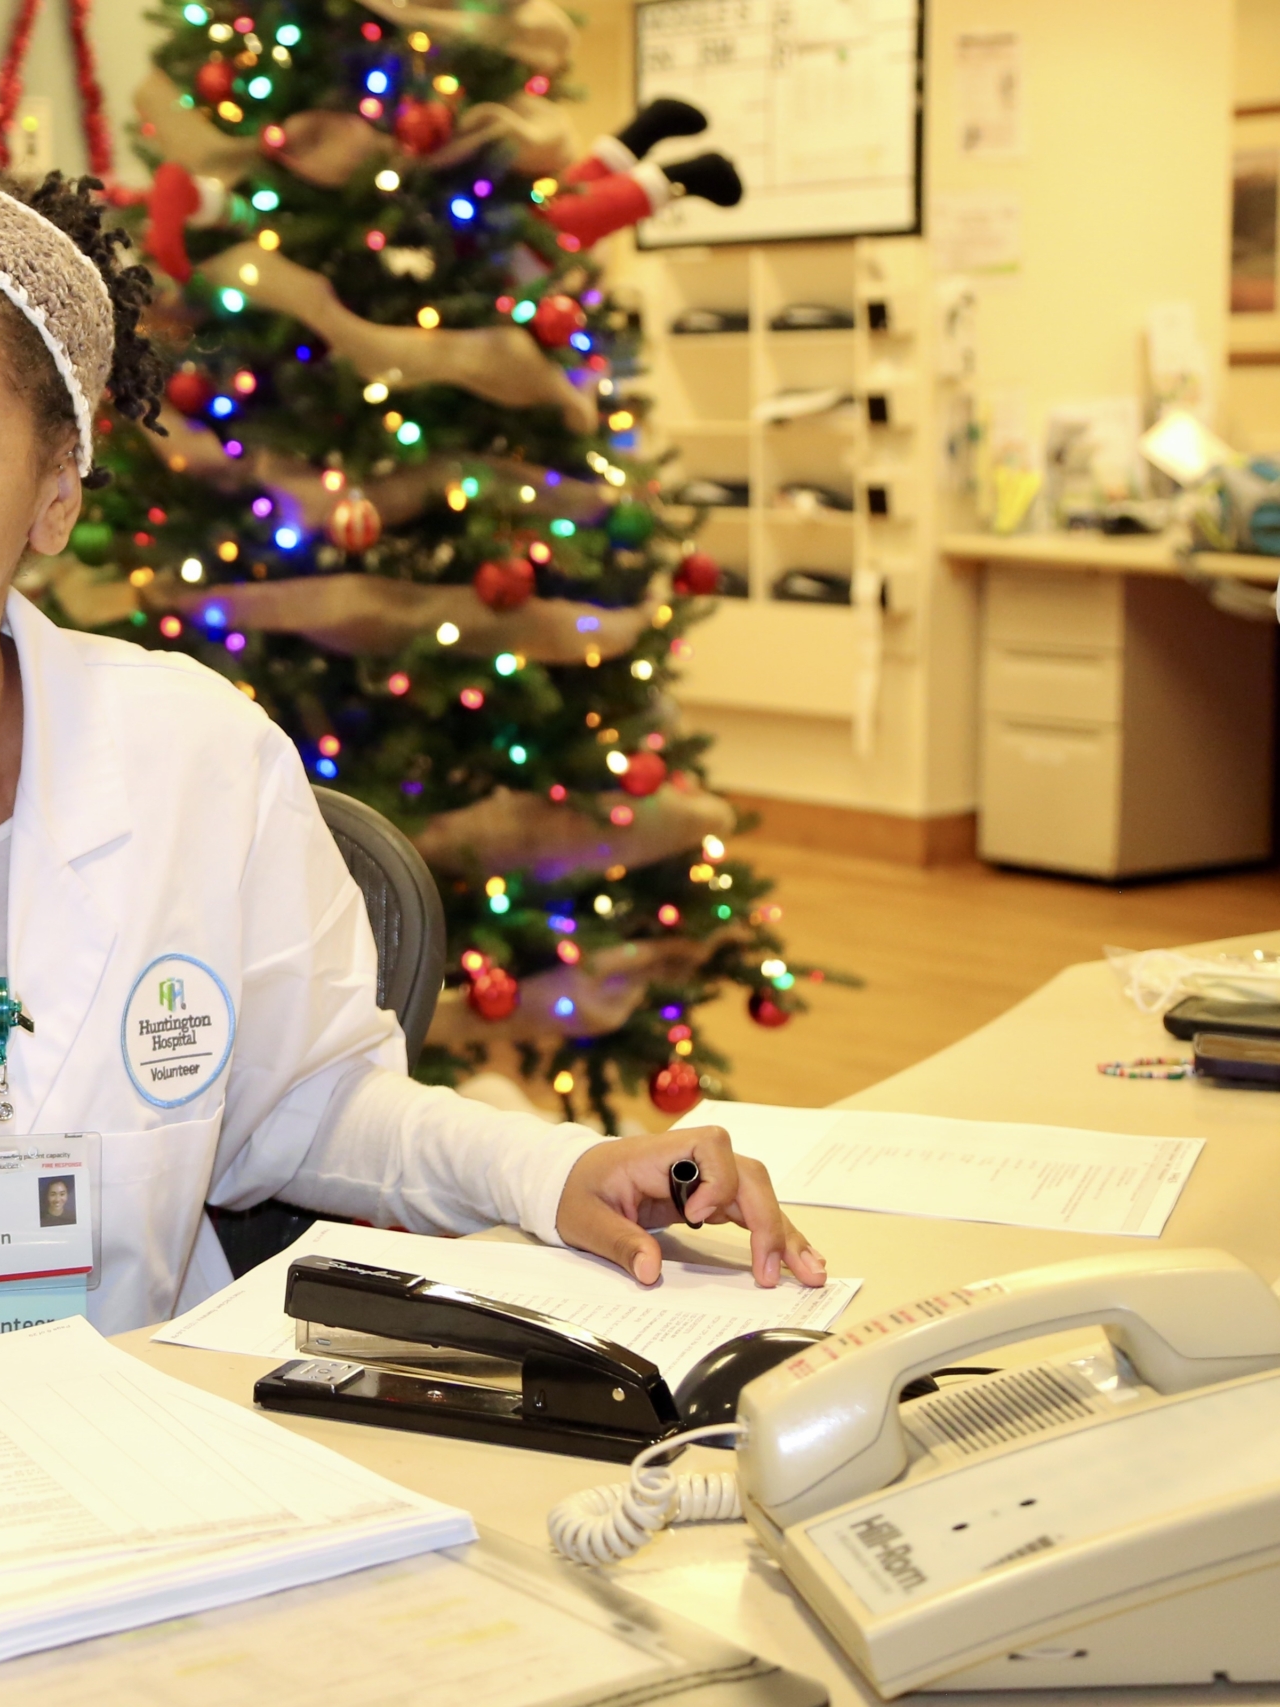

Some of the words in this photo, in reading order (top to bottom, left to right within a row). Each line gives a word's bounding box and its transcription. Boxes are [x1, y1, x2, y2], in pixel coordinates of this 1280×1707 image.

[138, 1014, 212, 1036] Huntington
[151, 1030, 197, 1051] Hospital
[150, 1063, 201, 1082] Volunteer
[849, 1513, 927, 1592] Hill-Rom
